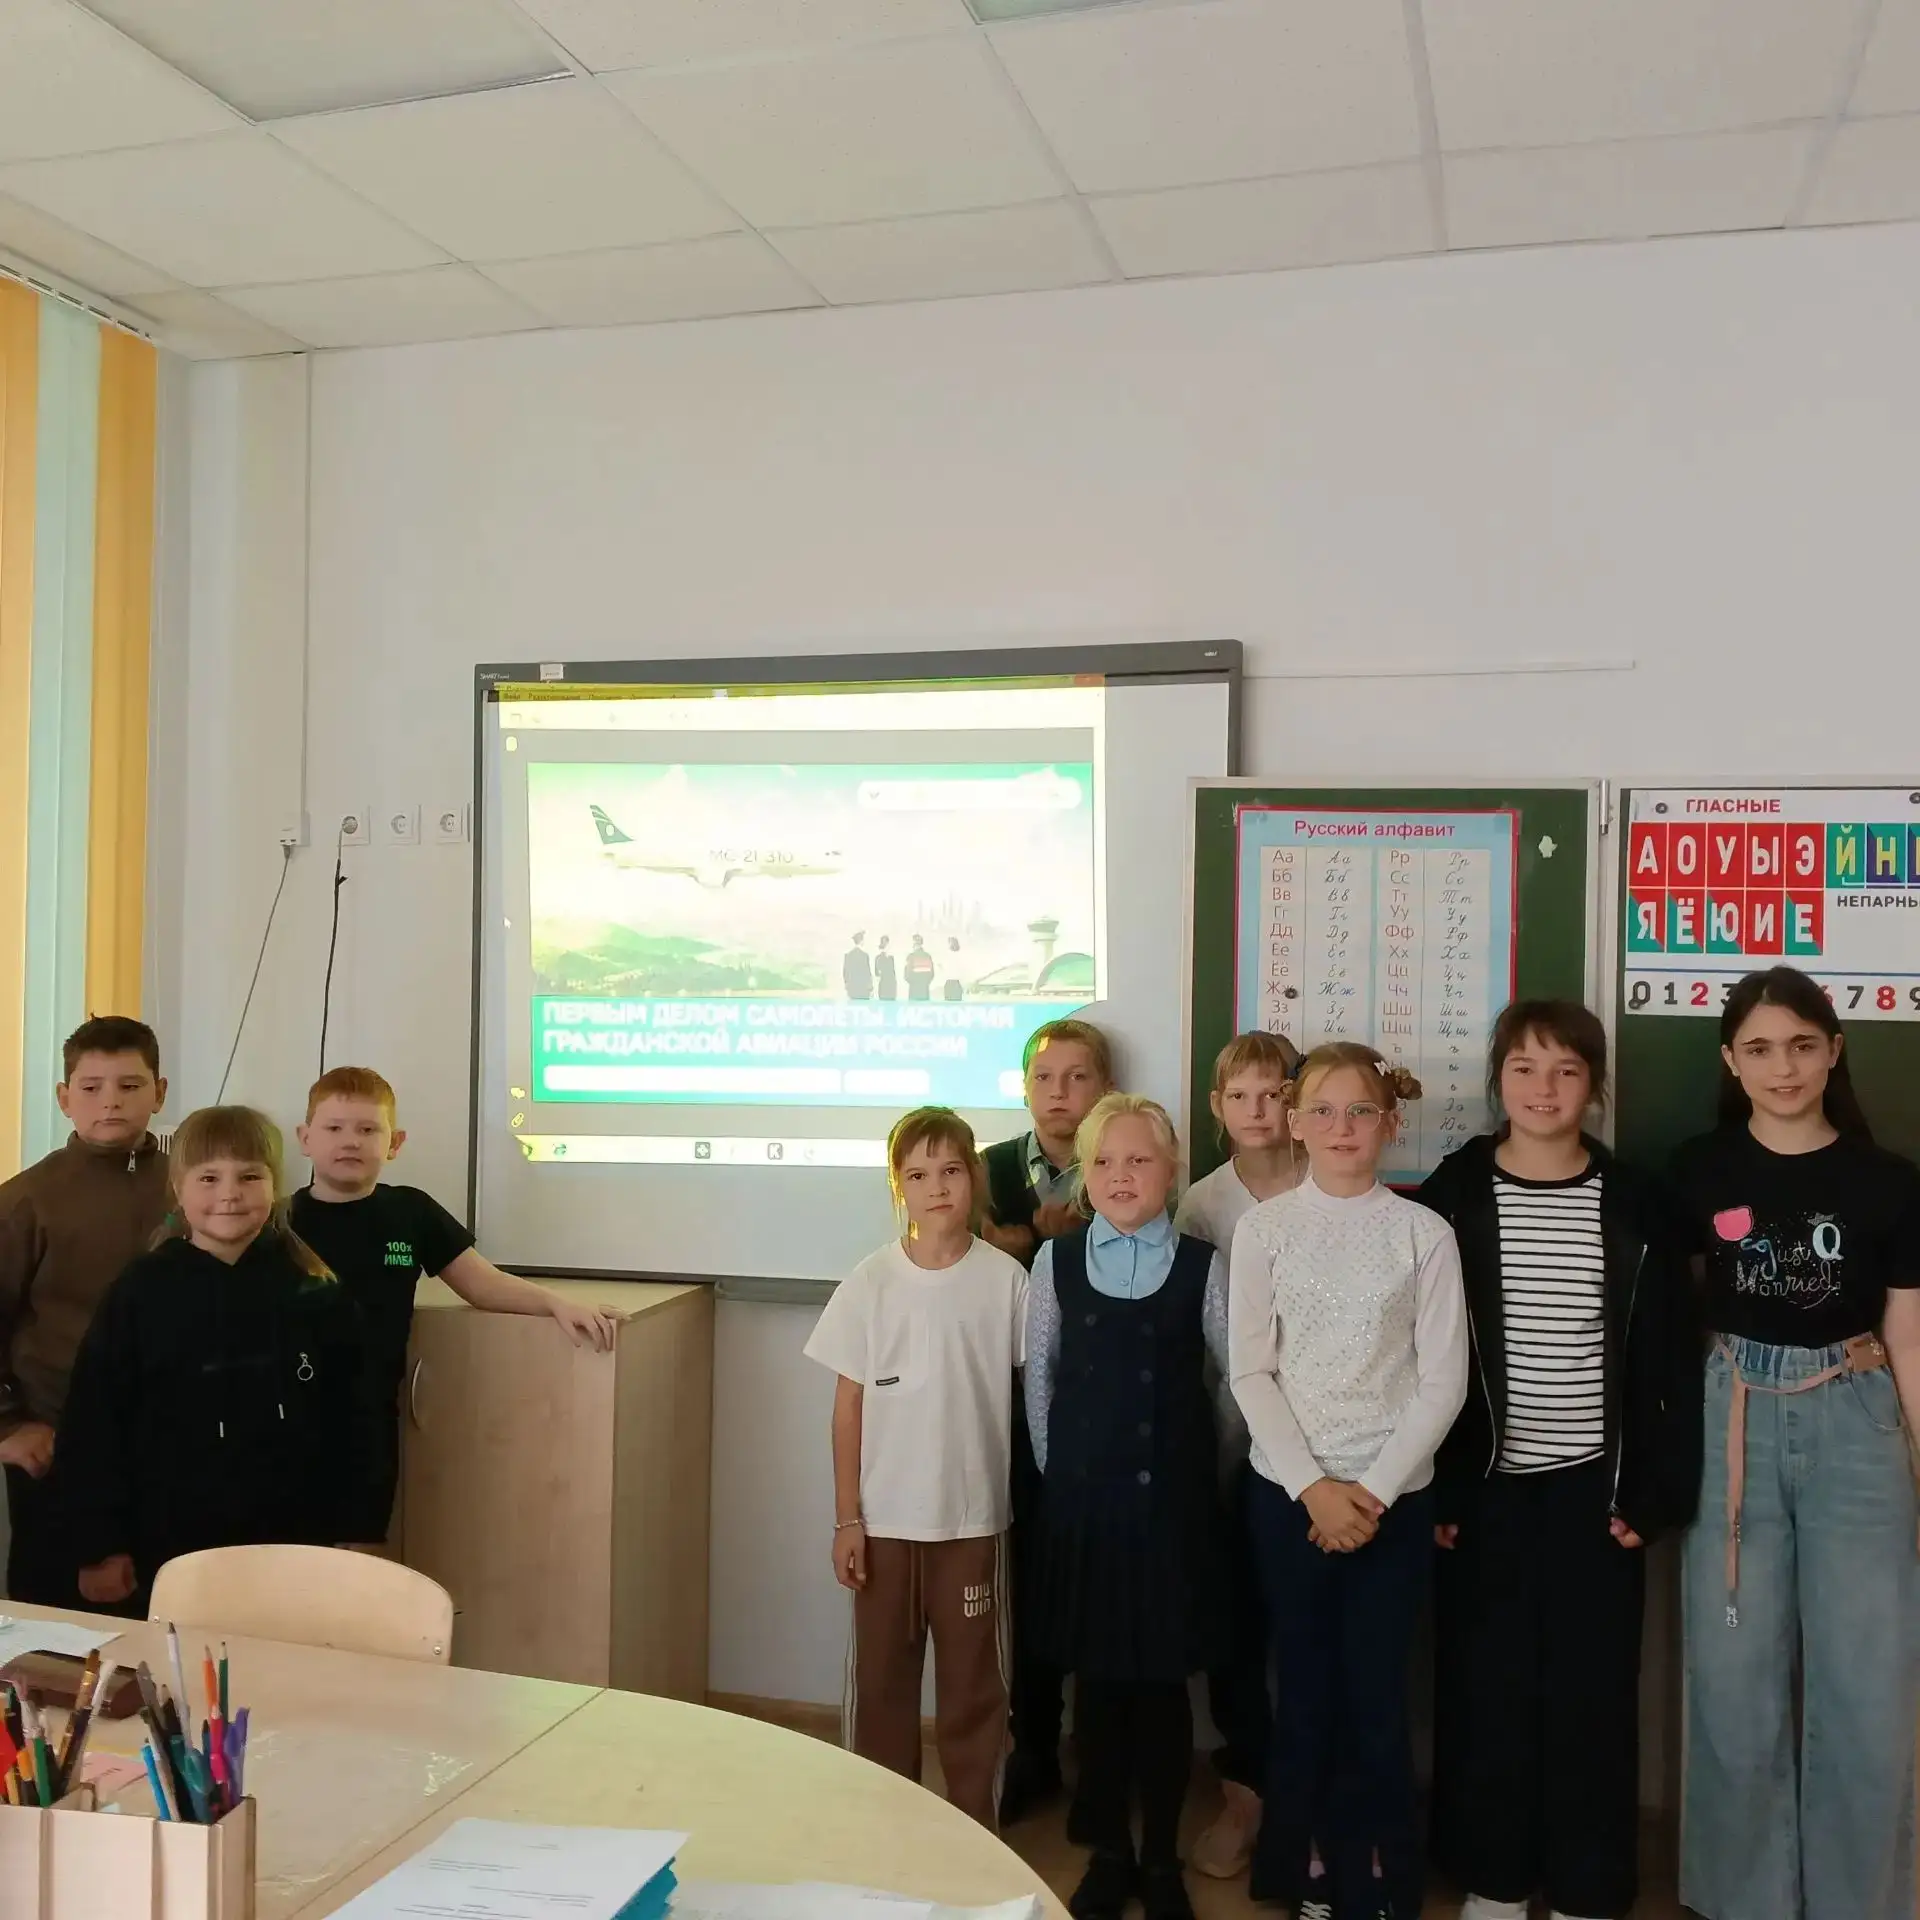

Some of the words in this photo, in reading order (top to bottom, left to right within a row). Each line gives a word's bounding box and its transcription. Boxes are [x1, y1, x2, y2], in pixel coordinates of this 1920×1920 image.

[1686, 799, 1781, 813] ГЛАСНЫЕ
[1295, 820, 1368, 838] Русский
[1374, 821, 1455, 839] алфавит
[1273, 850, 1294, 863] Аа
[1637, 836, 1658, 874] А
[1677, 835, 1697, 875] О
[1716, 836, 1737, 875] У
[1752, 836, 1779, 875] Ы
[1795, 835, 1815, 876] Э
[1836, 824, 1856, 875] Й
[1876, 837, 1897, 875] Н
[1273, 868, 1292, 882] Бб
[1273, 887, 1291, 900] Вв
[1637, 902, 1656, 940] Я
[1676, 898, 1695, 944] Ё
[1711, 902, 1739, 942] Ю
[1754, 903, 1774, 942] И
[1795, 903, 1813, 943] Е
[1270, 923, 1293, 938] Дд
[1385, 924, 1414, 940] Фф
[1664, 982, 1678, 1005] 1
[1690, 982, 1708, 1006] 2
[1847, 986, 1864, 1010] 7
[1876, 985, 1897, 1010] 8
[543, 1001, 647, 1024] ПЕРВЫМ
[652, 1002, 740, 1027] ДЕЛОМ
[896, 1005, 1015, 1029] ИСТОРИЯ
[543, 1027, 731, 1055] ГРАЖДАНСКОЙ
[736, 1032, 858, 1058] АВИАЦИИ
[864, 1034, 968, 1058] РОССИИ
